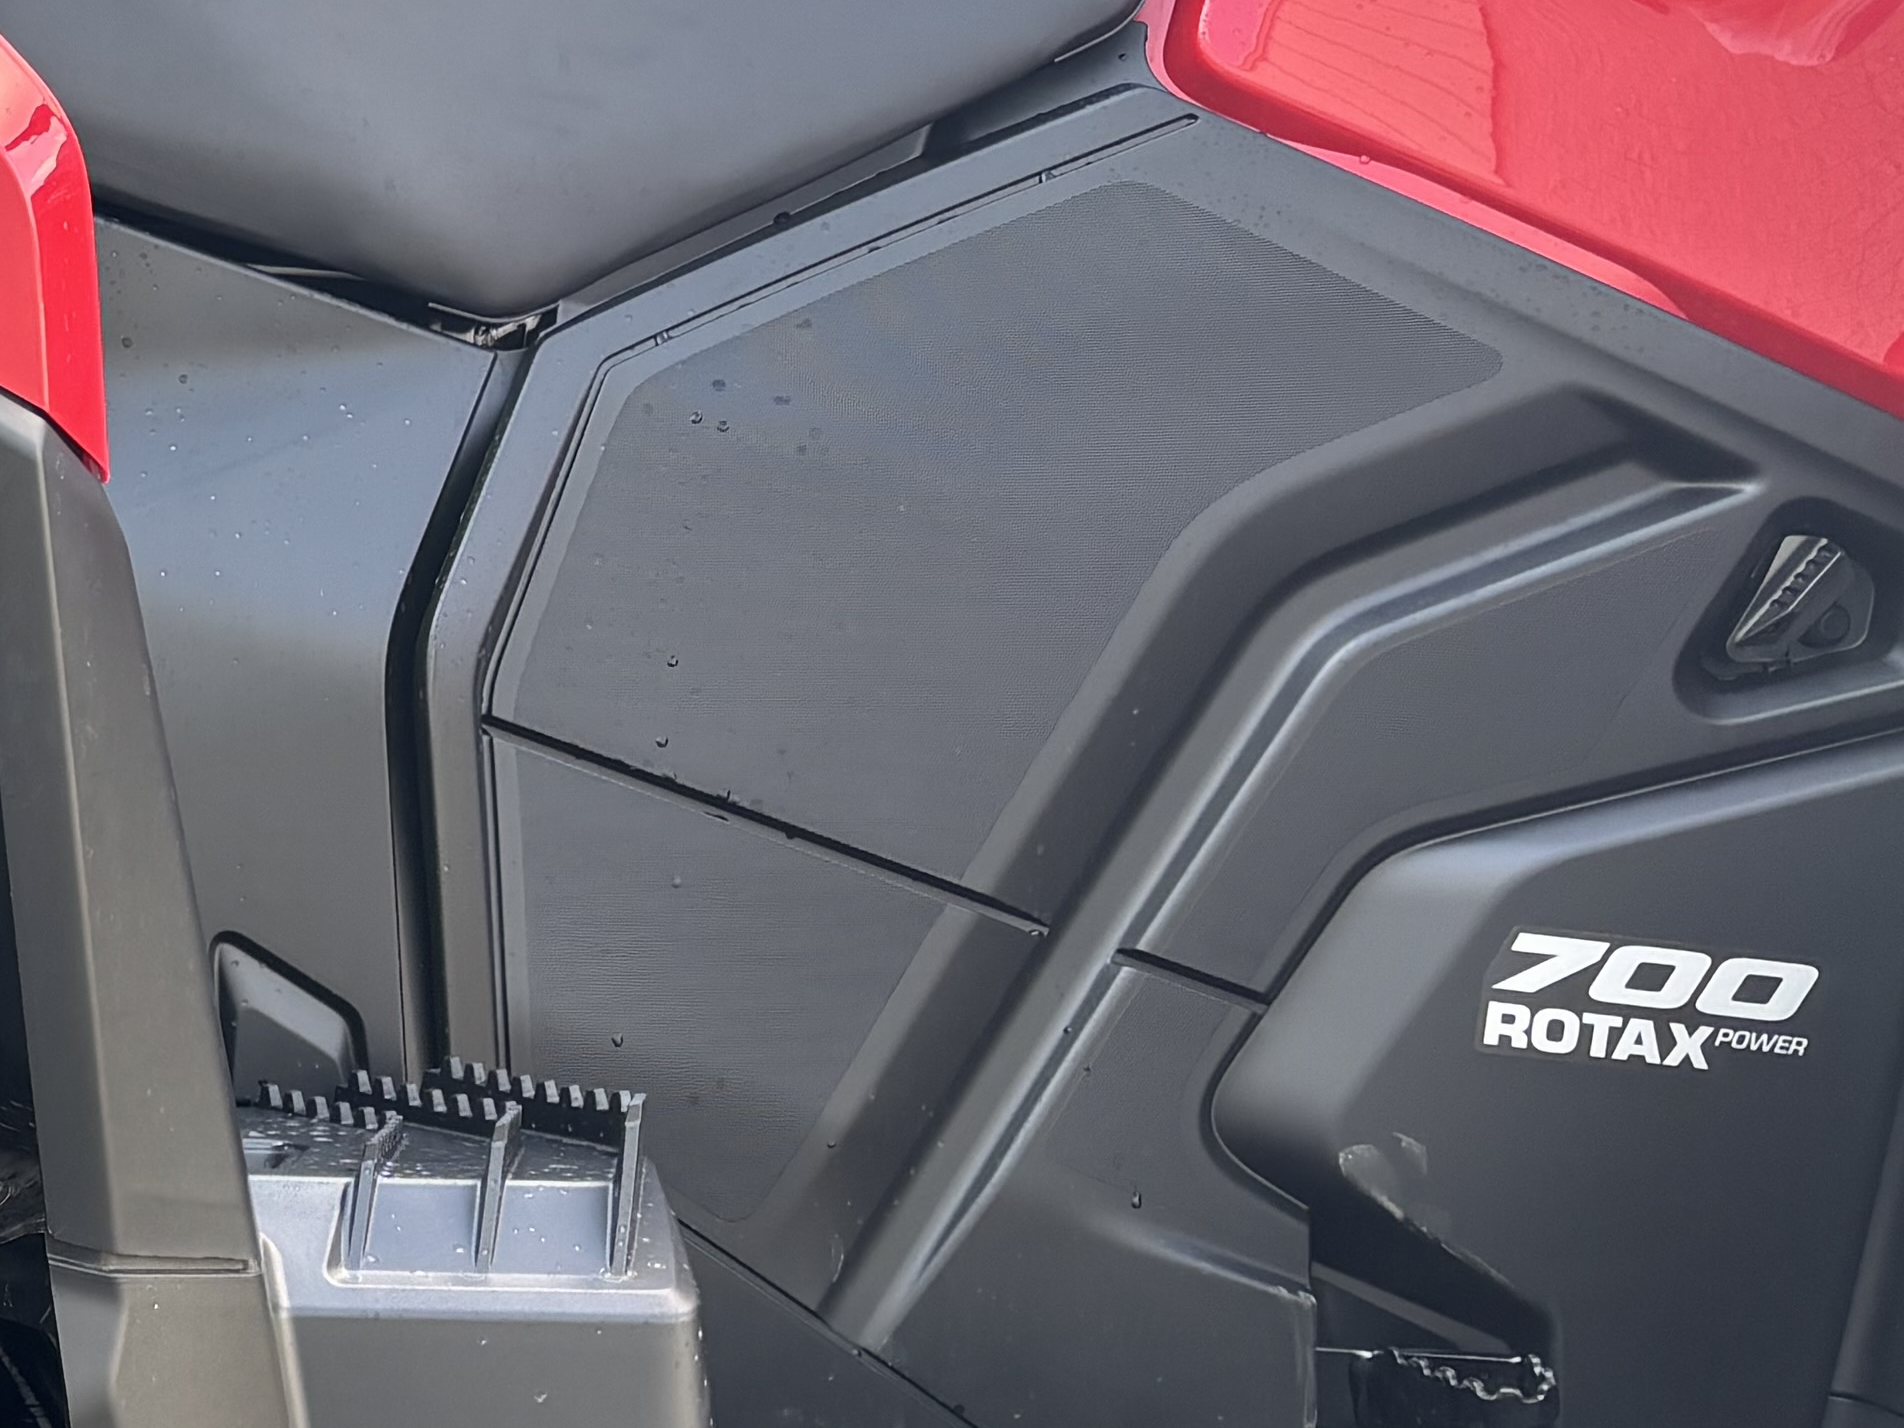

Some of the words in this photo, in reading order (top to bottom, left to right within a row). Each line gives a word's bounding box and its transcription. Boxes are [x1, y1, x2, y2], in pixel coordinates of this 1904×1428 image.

[1491, 932, 1819, 1021] 700
[1483, 1001, 1714, 1070] ROTAX
[1714, 1028, 1809, 1056] POWER
